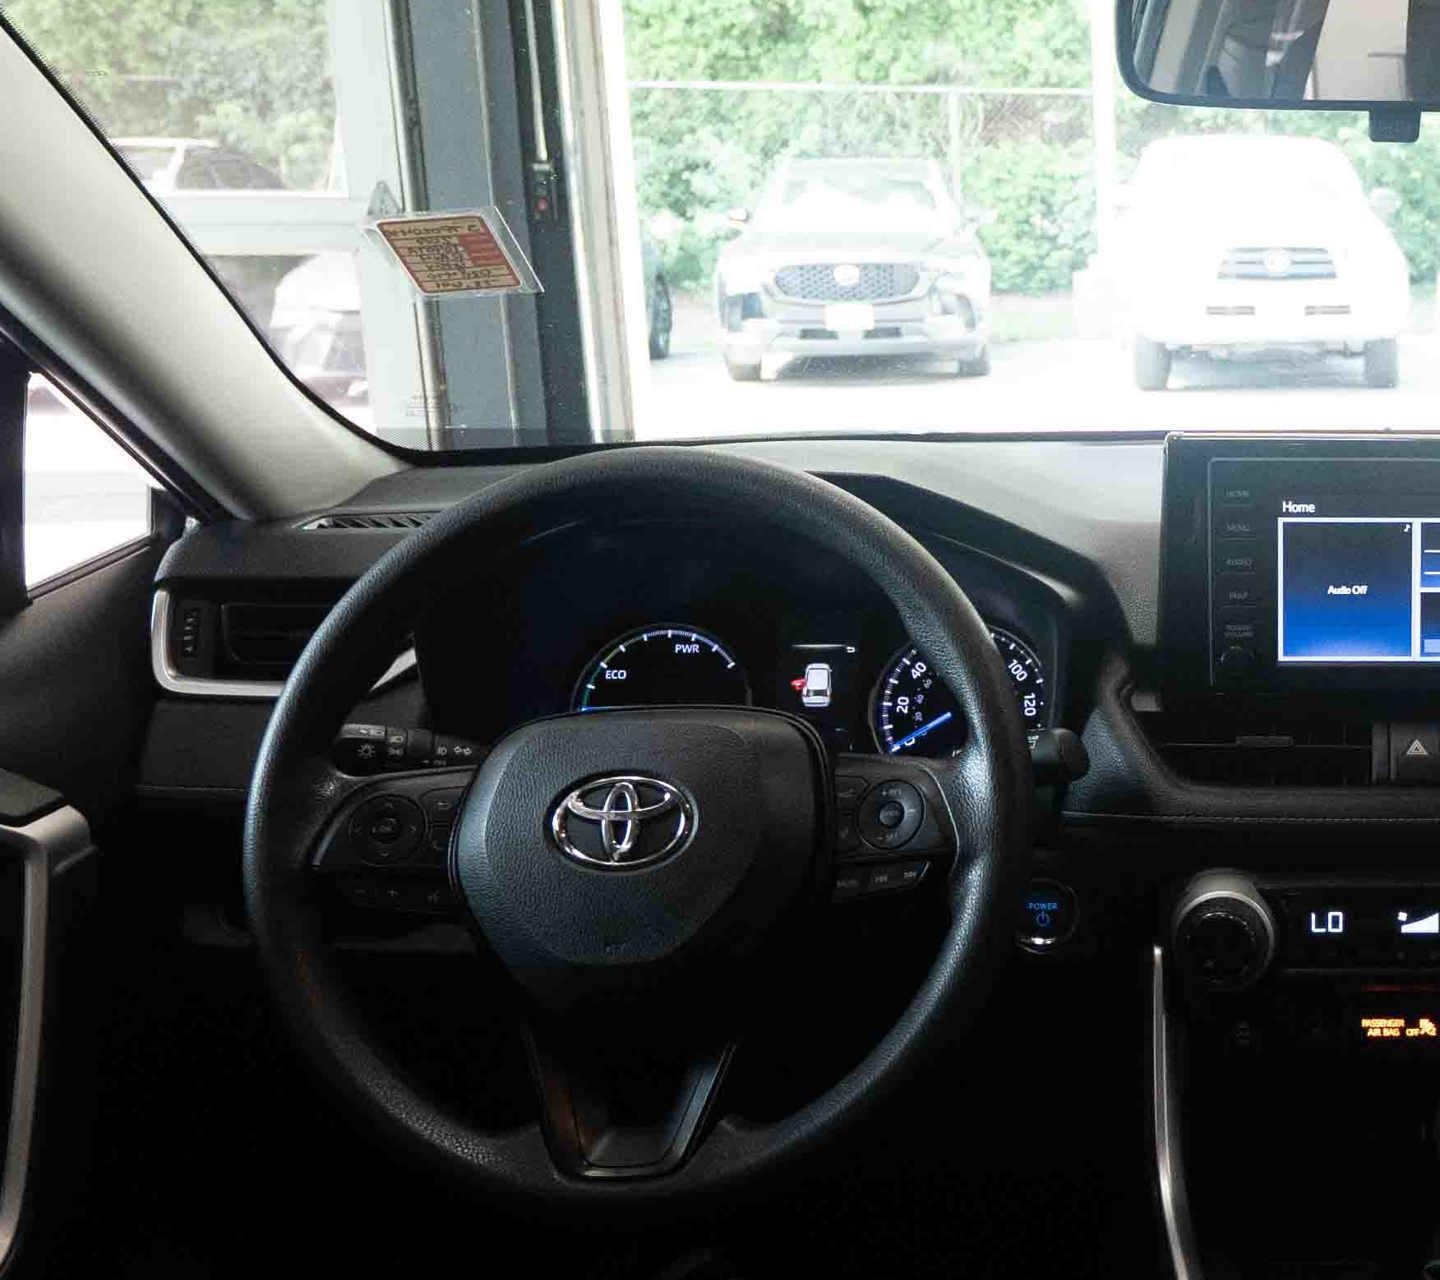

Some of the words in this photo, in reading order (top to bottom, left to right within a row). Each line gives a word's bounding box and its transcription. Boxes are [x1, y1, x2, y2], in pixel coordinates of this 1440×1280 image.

[1282, 501, 1316, 513] Home
[1327, 585, 1351, 595] Audio
[1351, 585, 1368, 595] Off
[674, 643, 700, 654] PWR
[605, 669, 627, 681] ECO
[911, 662, 927, 680] 40
[1007, 659, 1028, 682] 100
[896, 696, 910, 715] 20
[1023, 692, 1037, 717] 120
[1027, 902, 1058, 911] POWER
[1310, 911, 1344, 934] LO
[1361, 1018, 1405, 1028] PASSENGER
[1367, 1028, 1382, 1037] AIR
[1382, 1028, 1401, 1037] BAG
[1405, 1028, 1420, 1037] OFF
